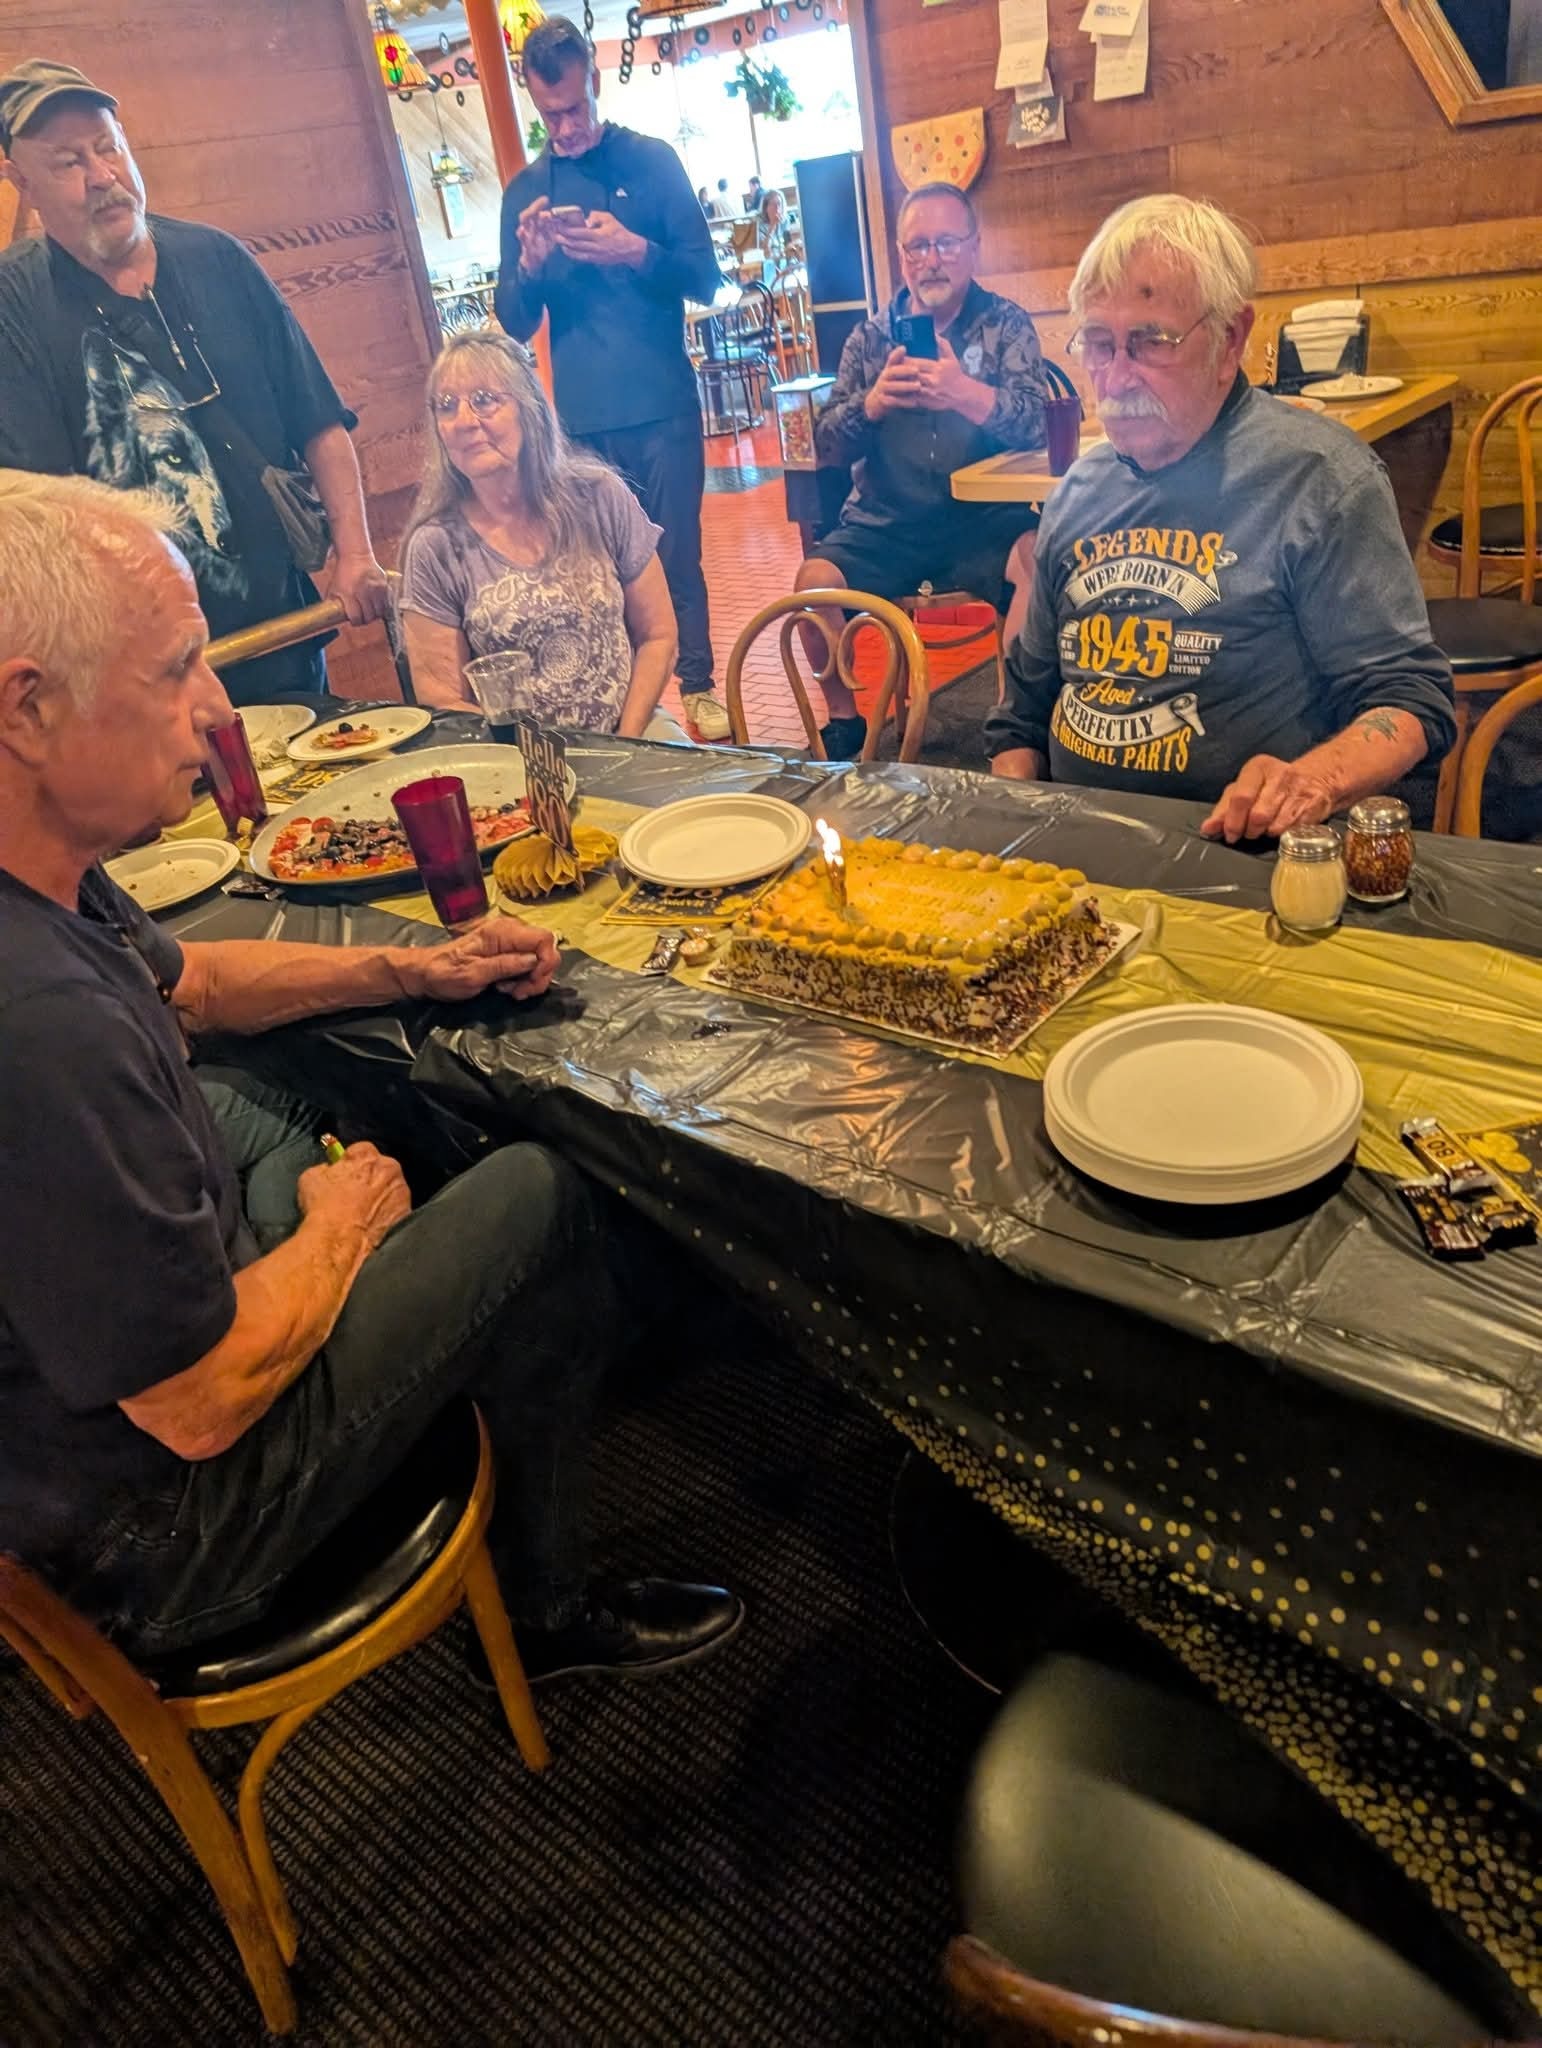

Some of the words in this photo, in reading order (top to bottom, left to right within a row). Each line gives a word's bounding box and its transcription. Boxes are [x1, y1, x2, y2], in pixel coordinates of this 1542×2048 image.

[1073, 527, 1225, 576] LEGENDS
[1122, 561, 1170, 588] BORN
[1167, 573, 1189, 597] IN
[1077, 613, 1173, 678] 1945
[1174, 633, 1223, 650] QUALITY
[1174, 653, 1211, 665] LIMITED
[1169, 664, 1201, 676] EDITION
[1080, 679, 1136, 706] Aged
[1065, 695, 1153, 742] PERFECTLY
[519, 724, 566, 781] Hello
[1059, 720, 1117, 766] ORIGINAL
[1122, 726, 1193, 772] PARTS
